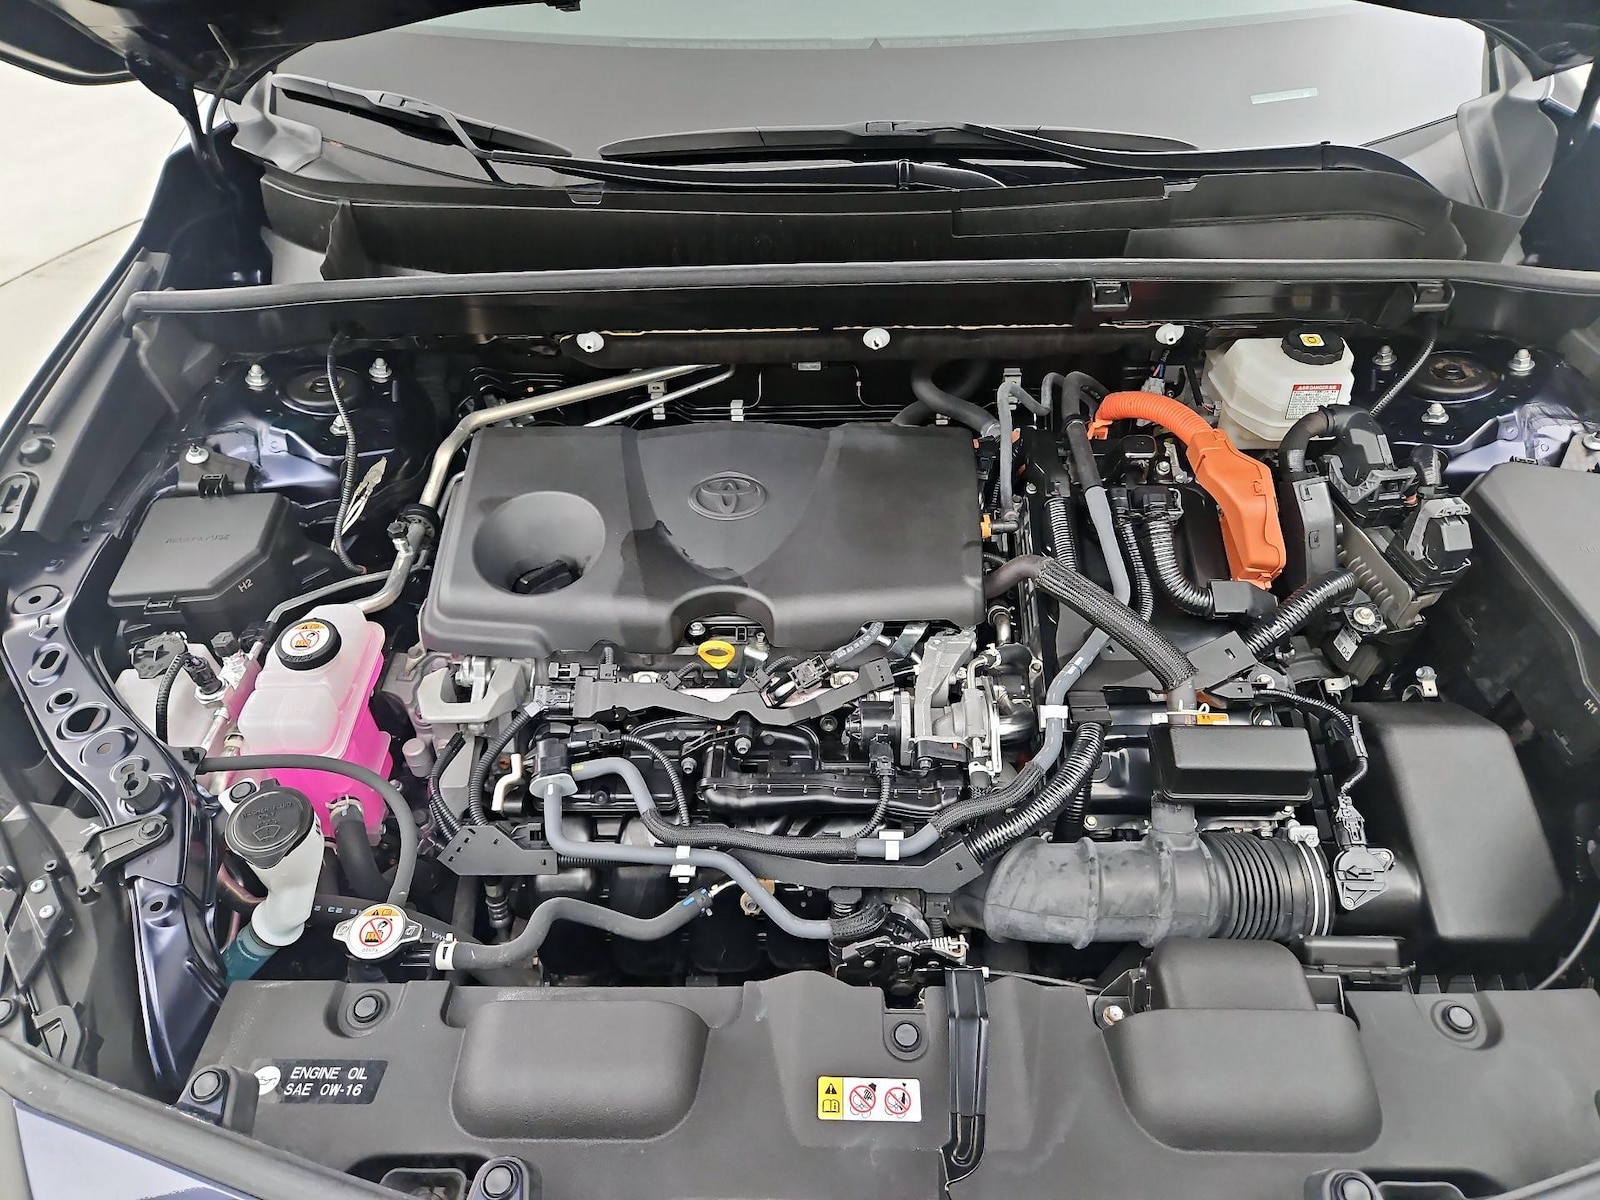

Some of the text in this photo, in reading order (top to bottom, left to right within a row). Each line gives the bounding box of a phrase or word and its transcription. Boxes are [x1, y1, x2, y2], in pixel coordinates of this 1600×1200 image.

[237, 578, 254, 593] H2
[1583, 698, 1598, 714] H1
[290, 1066, 368, 1080] ENGINE OIL
[283, 1082, 363, 1097] SAE 0W-16
